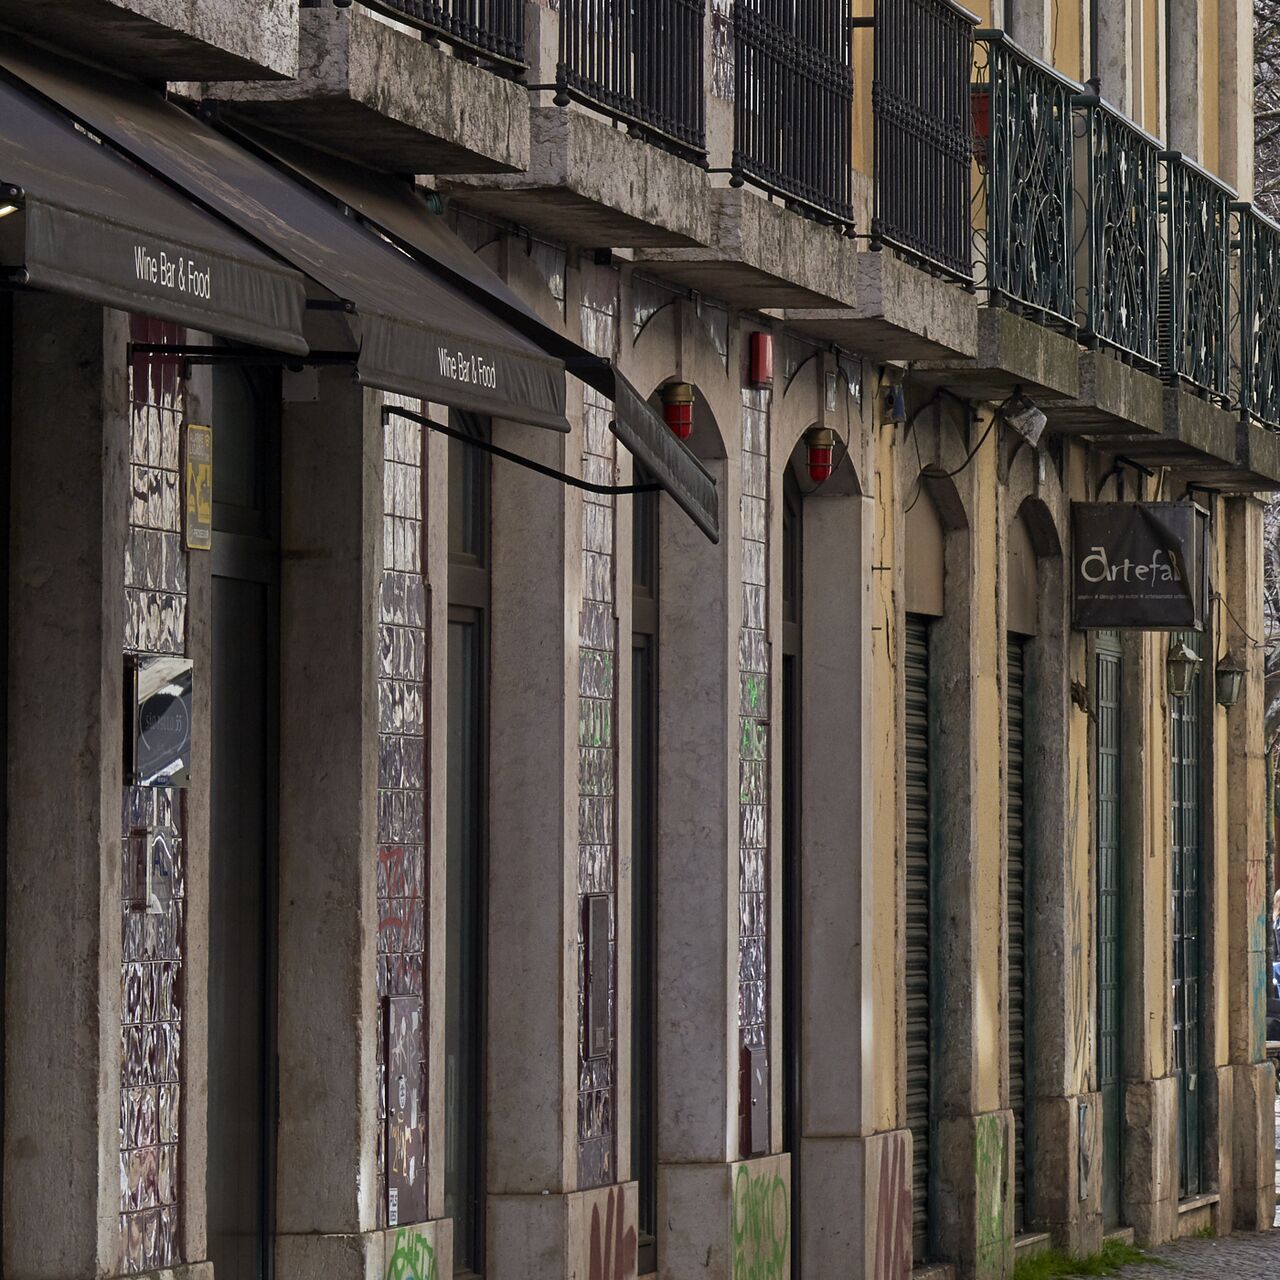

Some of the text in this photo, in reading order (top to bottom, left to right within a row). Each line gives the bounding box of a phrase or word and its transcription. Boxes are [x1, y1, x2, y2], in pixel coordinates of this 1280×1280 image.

[134, 245, 211, 299] Wine Bar & Food
[438, 347, 496, 389] Wine Bar & Food
